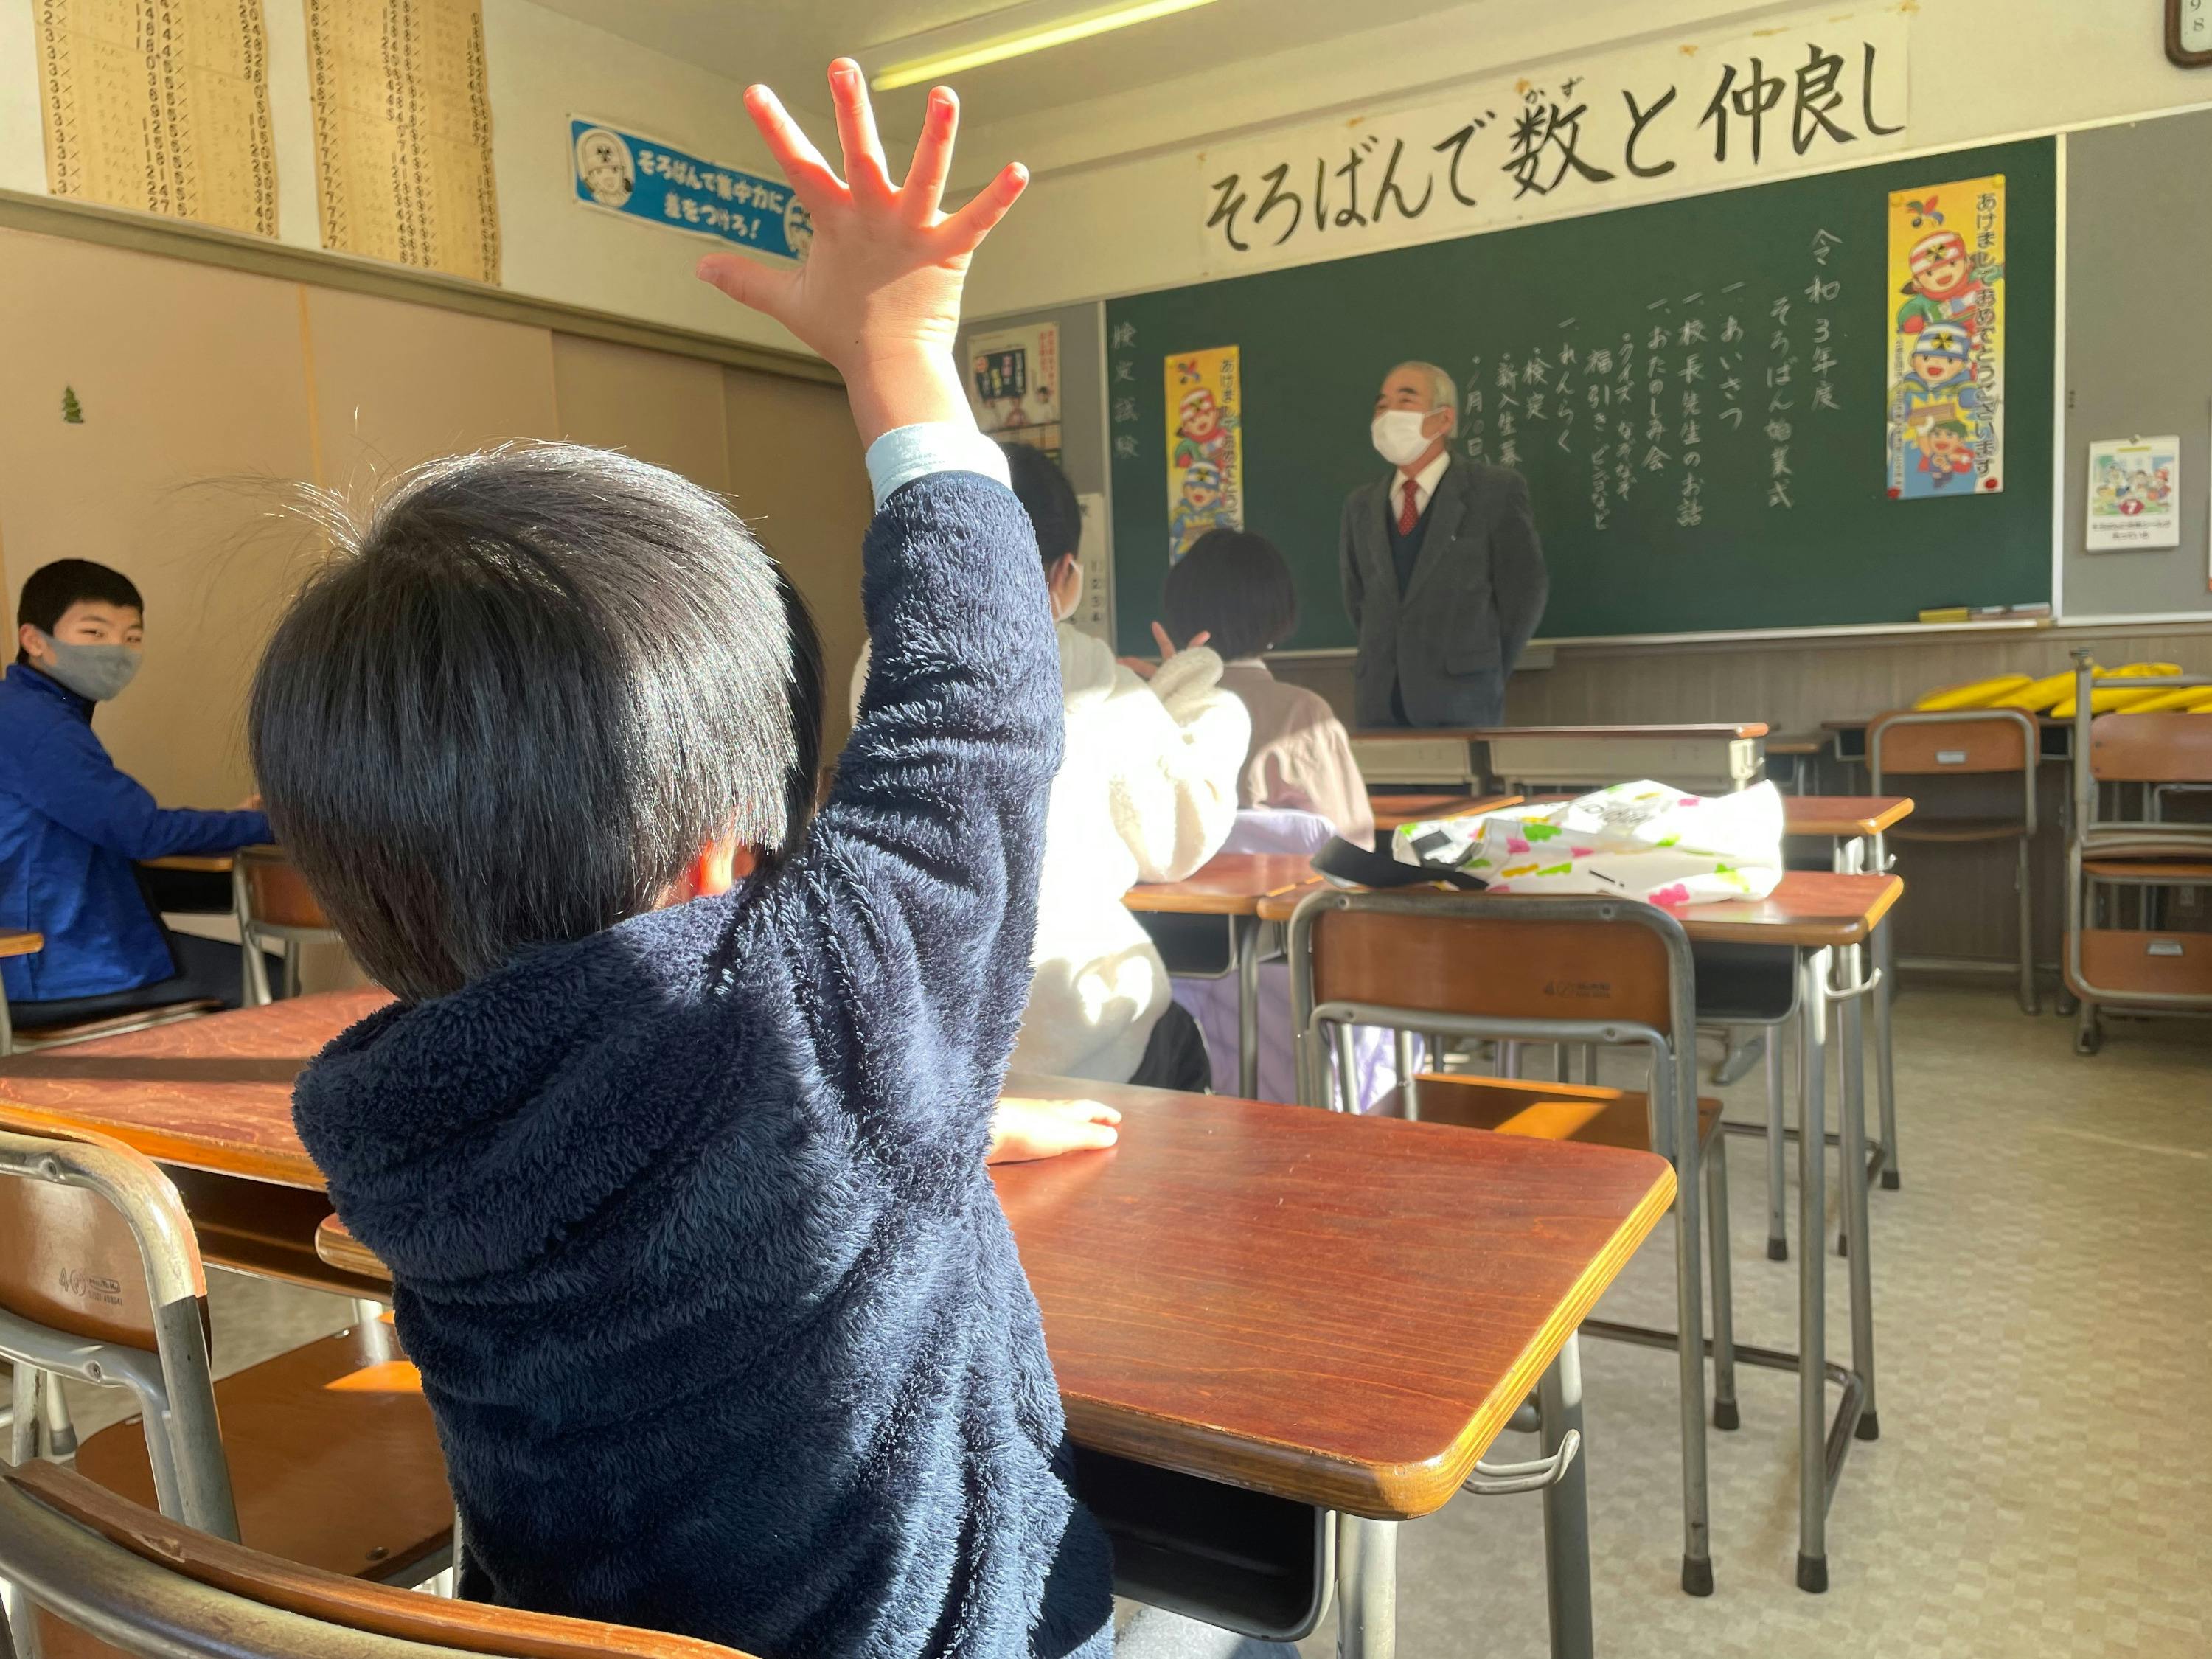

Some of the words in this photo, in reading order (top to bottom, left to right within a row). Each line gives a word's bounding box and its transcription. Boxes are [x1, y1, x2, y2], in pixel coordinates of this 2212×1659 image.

[2193, 18, 2204, 31] 8
[1526, 76, 1585, 104] かず
[1804, 229, 1843, 411] 令和3年度
